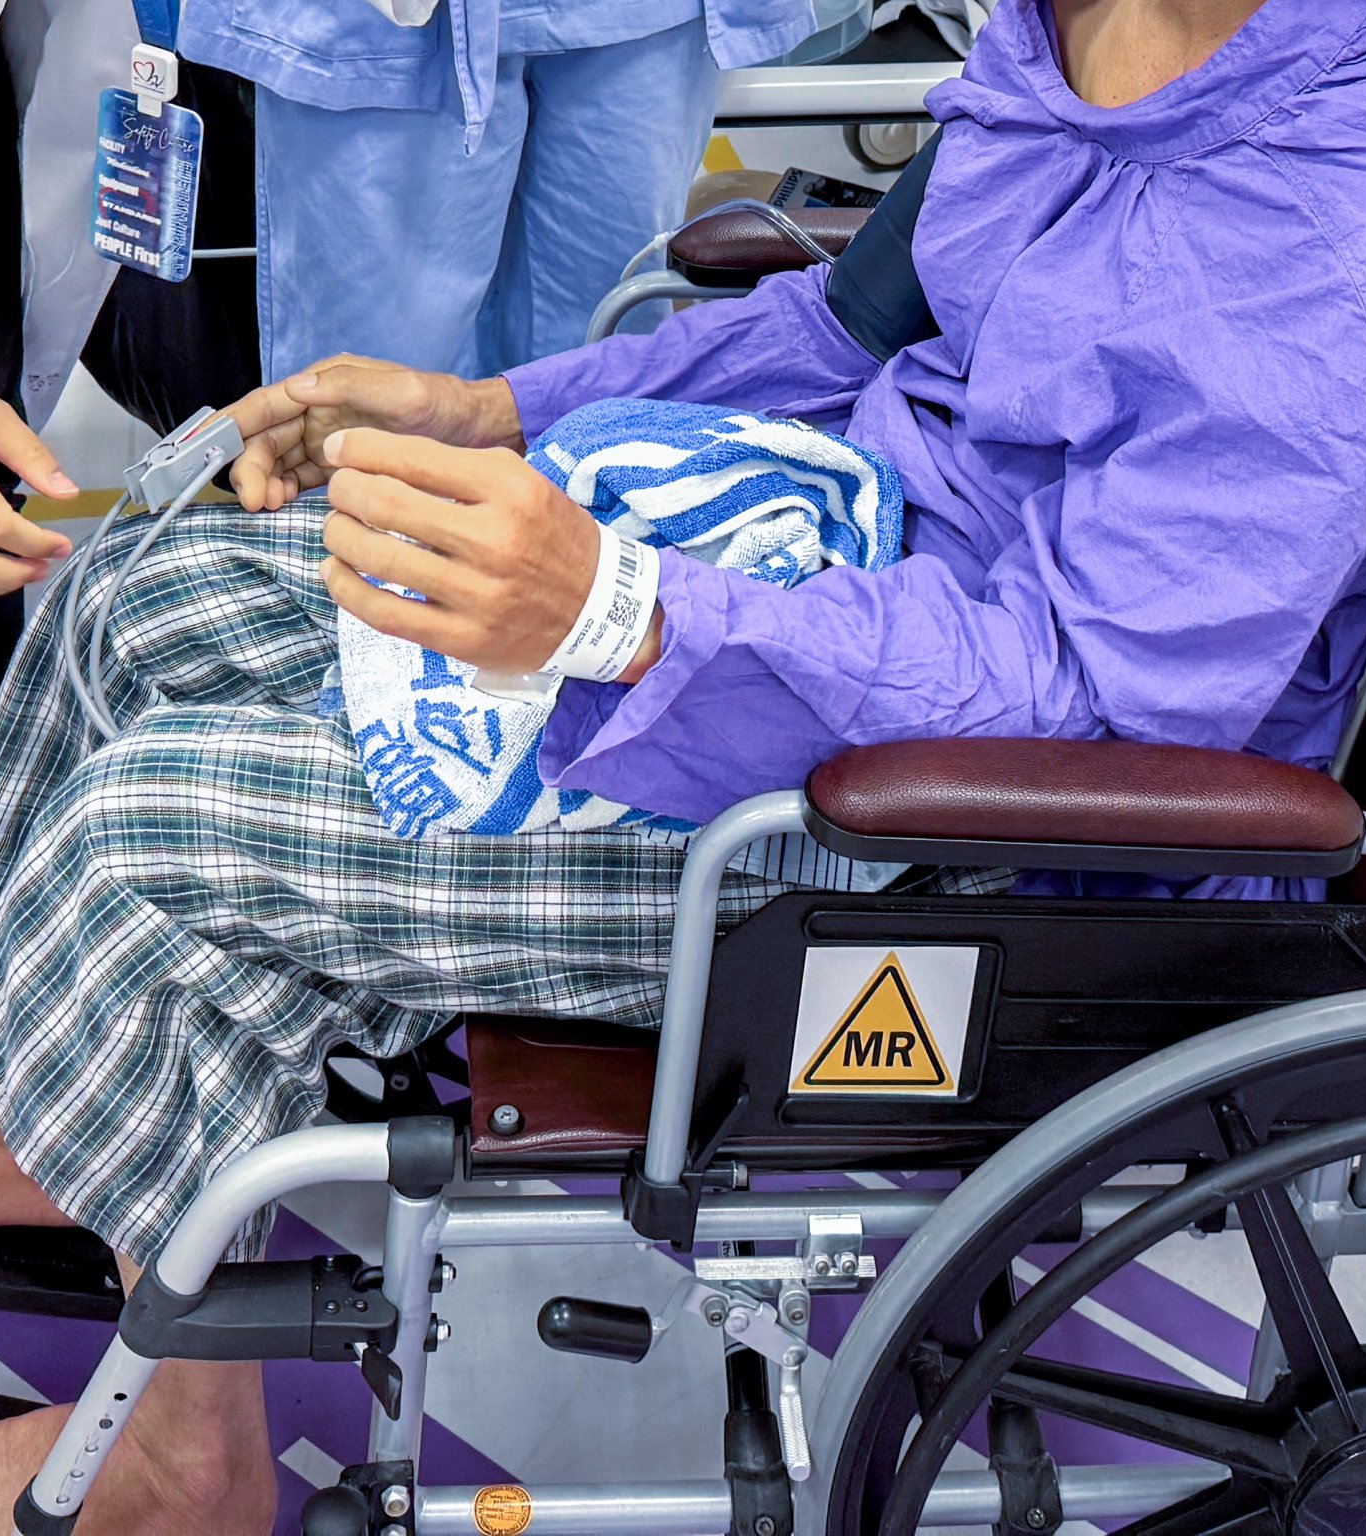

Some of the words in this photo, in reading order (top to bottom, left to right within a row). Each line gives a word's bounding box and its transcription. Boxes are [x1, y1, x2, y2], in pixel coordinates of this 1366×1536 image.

[773, 169, 804, 208] PHILIPS
[94, 231, 133, 258] PEOPLE
[134, 242, 161, 268] First
[842, 1030, 916, 1068] MR
